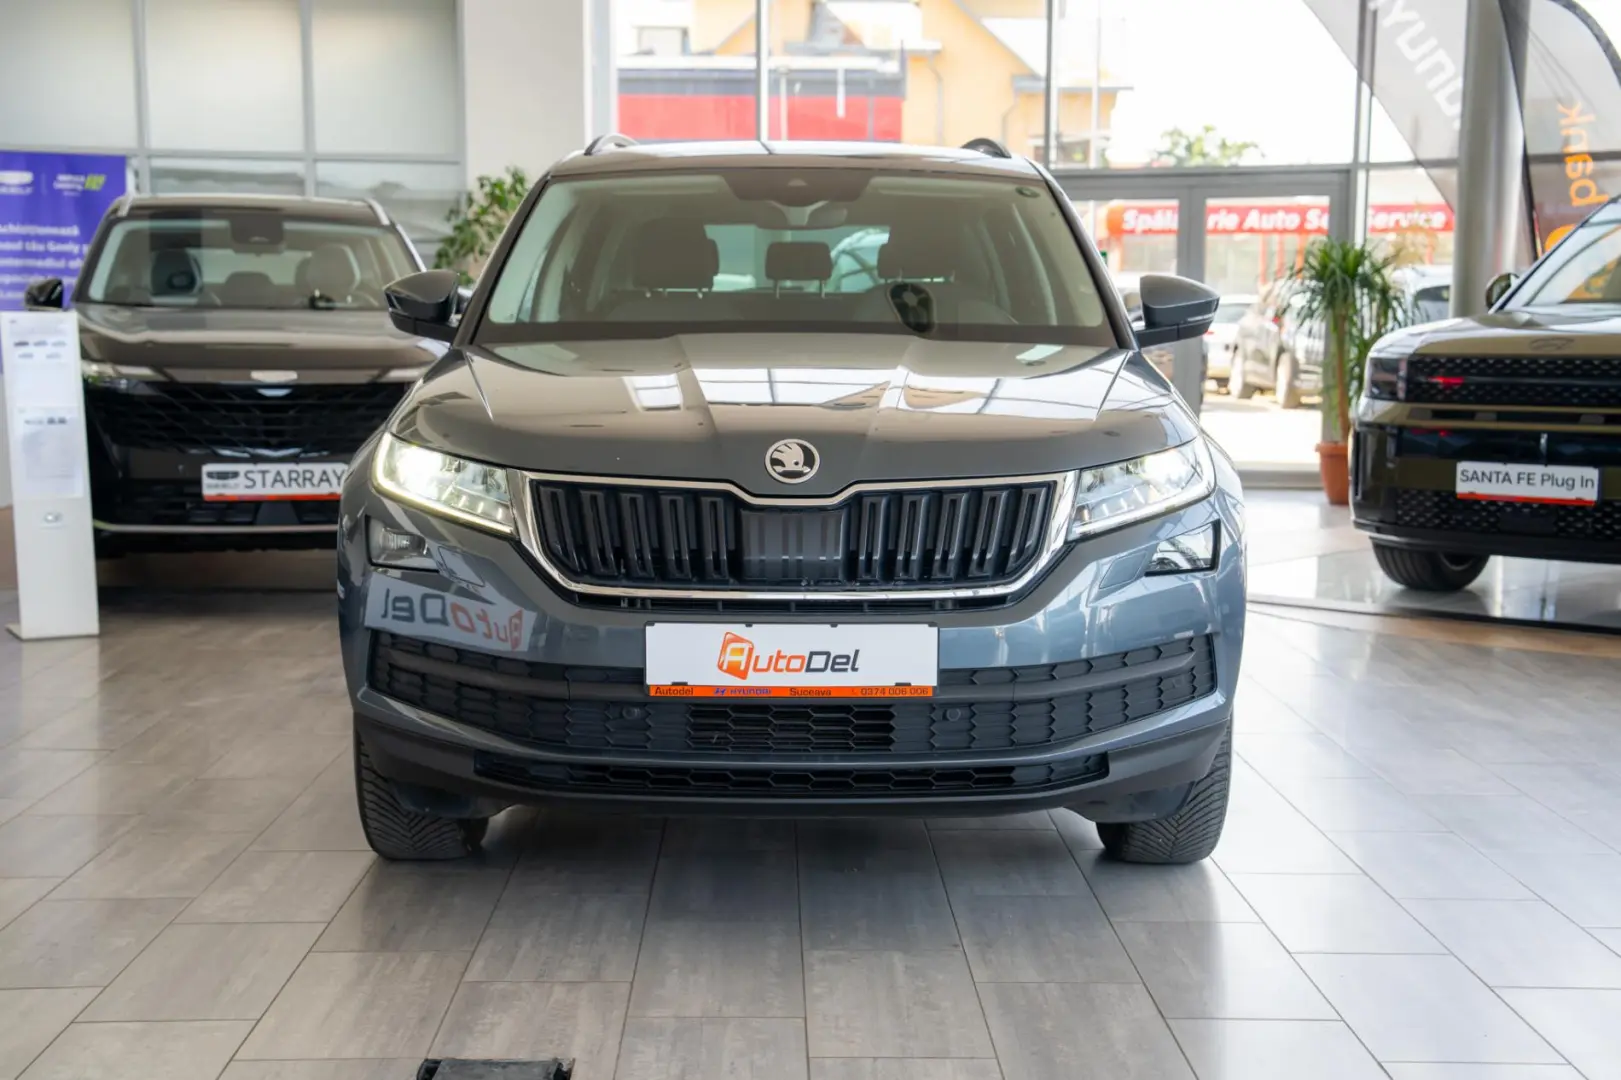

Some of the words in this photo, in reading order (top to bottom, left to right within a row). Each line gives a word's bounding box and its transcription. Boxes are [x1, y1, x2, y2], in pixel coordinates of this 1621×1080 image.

[1242, 208, 1300, 231] Auto
[244, 469, 345, 489] STARRAY
[1460, 468, 1512, 485] SANTA
[1516, 472, 1536, 486] FE
[1541, 473, 1576, 491] Plug
[1580, 475, 1595, 488] In
[719, 637, 860, 677] AutoDel
[655, 686, 694, 696] Autodel
[789, 687, 832, 697] Suceava
[860, 687, 886, 696] 0374
